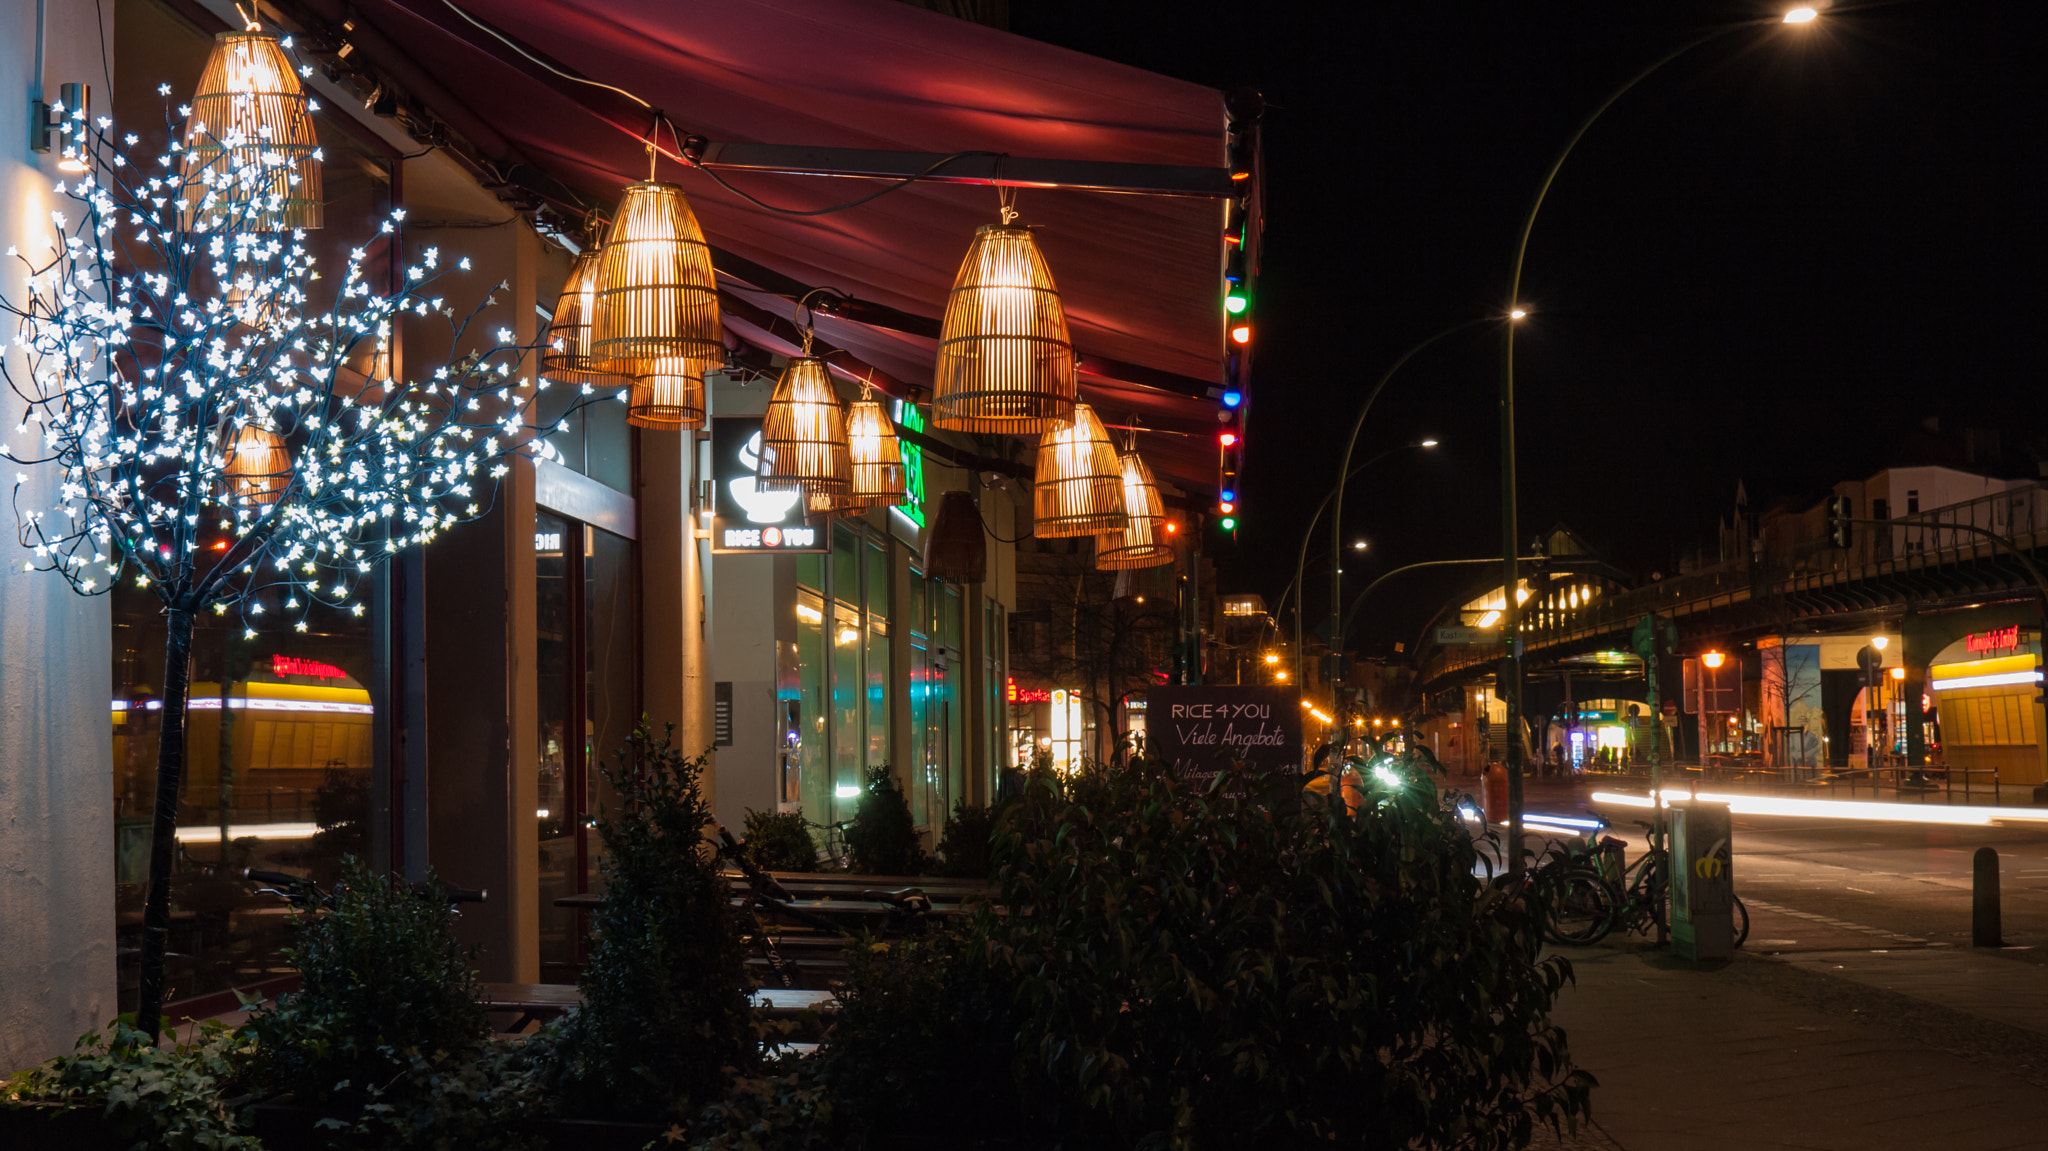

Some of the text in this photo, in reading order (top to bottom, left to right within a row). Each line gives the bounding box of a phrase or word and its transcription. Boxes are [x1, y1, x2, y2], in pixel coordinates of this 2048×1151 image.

[725, 529, 761, 547] RICE
[782, 528, 814, 546] YOU
[1171, 703, 1213, 719] RICE
[1231, 703, 1270, 719] YOU
[1175, 721, 1286, 759] Viele Angebote
